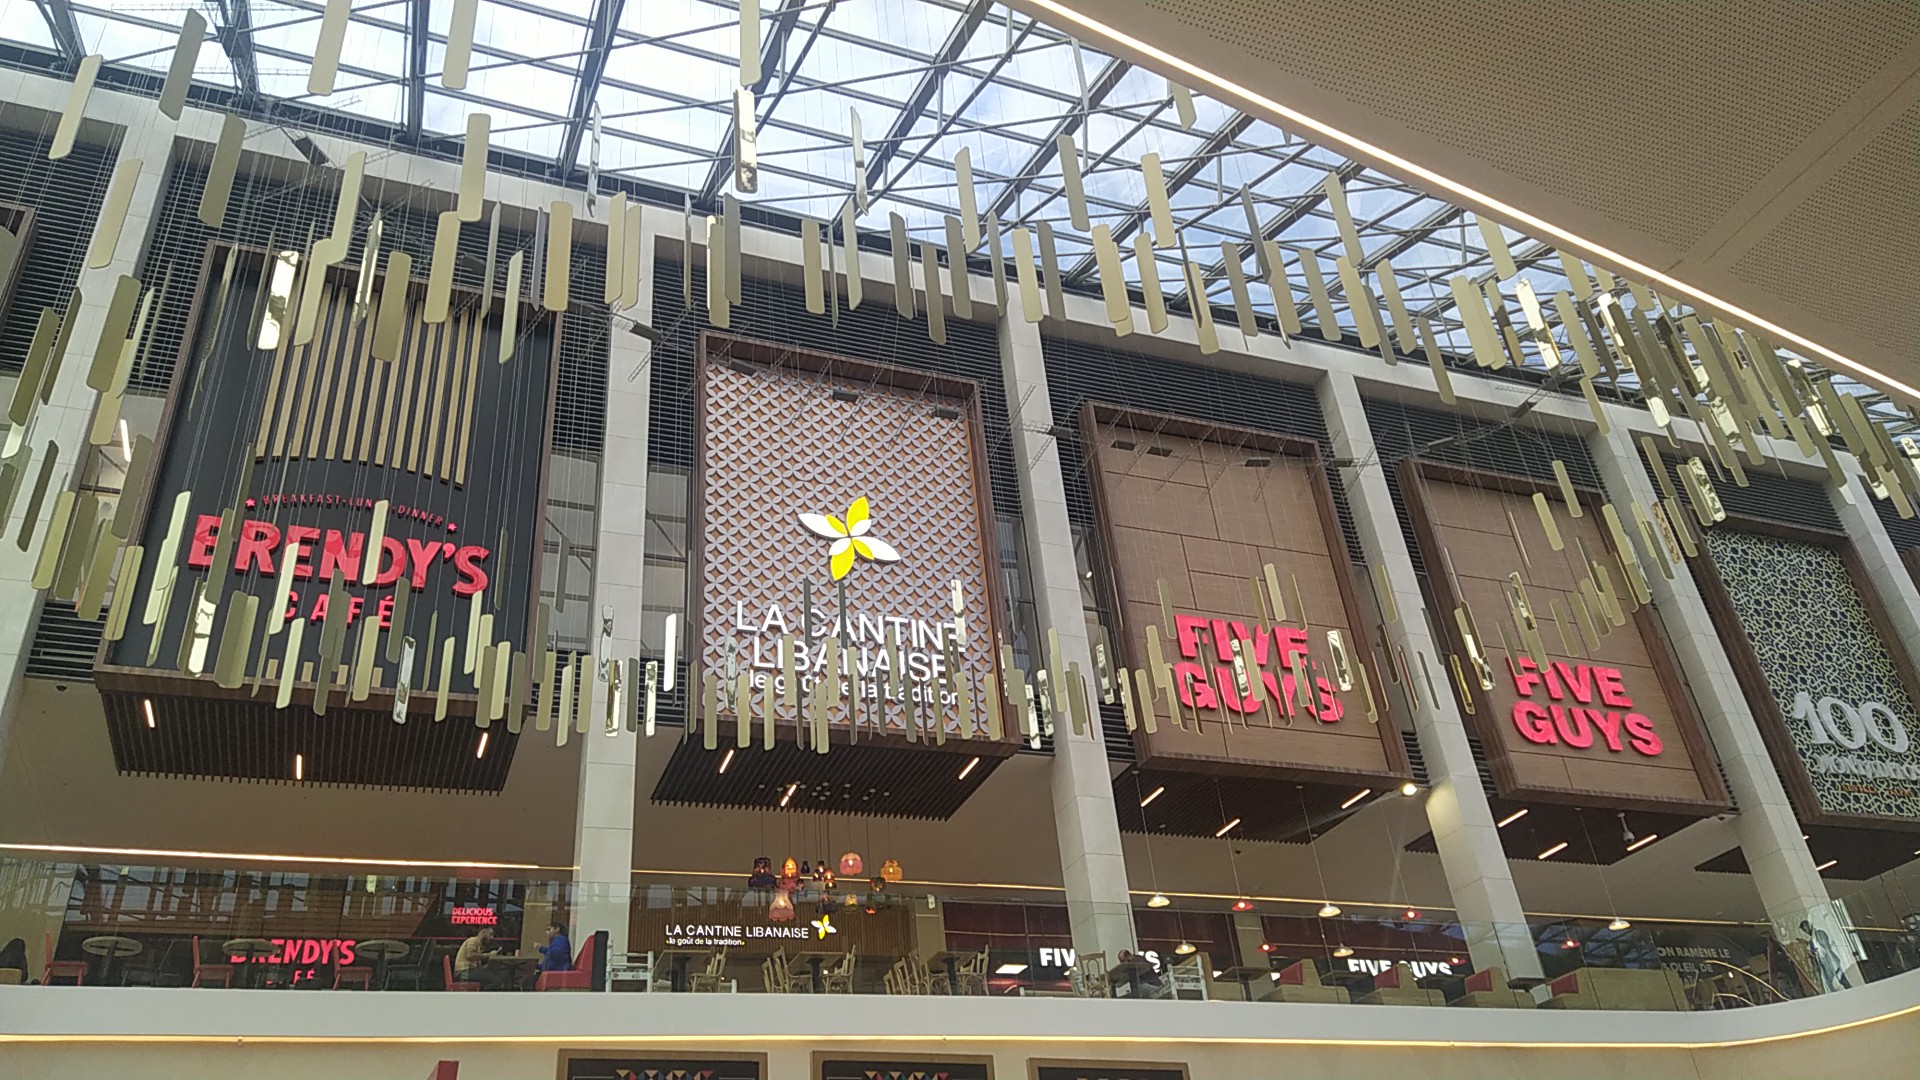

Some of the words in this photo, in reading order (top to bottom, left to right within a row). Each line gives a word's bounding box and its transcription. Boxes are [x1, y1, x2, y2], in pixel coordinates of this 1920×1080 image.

[188, 514, 490, 596] BRENDY'S
[736, 600, 789, 634] LA
[1174, 614, 1317, 671] FIVE
[1173, 661, 1344, 722] GUYS
[1506, 656, 1633, 708] FIVE
[1512, 700, 1663, 756] GUYS
[1794, 691, 1909, 753] 100
[451, 916, 498, 925] EXPERIENCE
[452, 907, 494, 916] DELICIOUS
[666, 925, 682, 936] LA
[686, 925, 742, 937] CANTINE
[746, 926, 809, 939] LIBANAISE
[714, 938, 742, 946] tradition
[1039, 948, 1076, 967] FIV
[1719, 948, 1731, 958] LE
